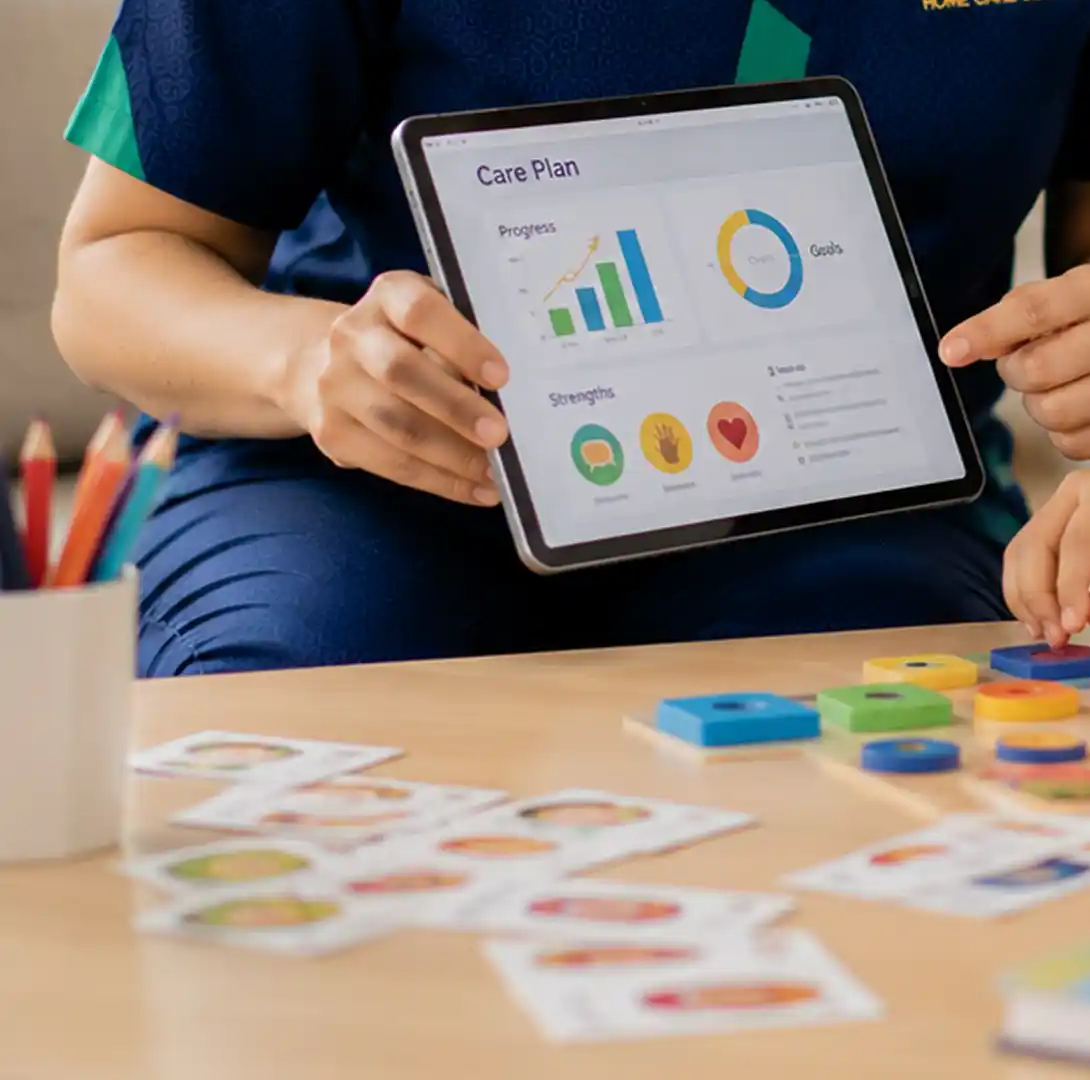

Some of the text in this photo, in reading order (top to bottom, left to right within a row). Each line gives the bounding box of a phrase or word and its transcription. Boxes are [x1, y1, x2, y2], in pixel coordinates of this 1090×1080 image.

[476, 157, 580, 186] Care Plan
[498, 222, 557, 239] Progress
[549, 385, 616, 407] Strengths
